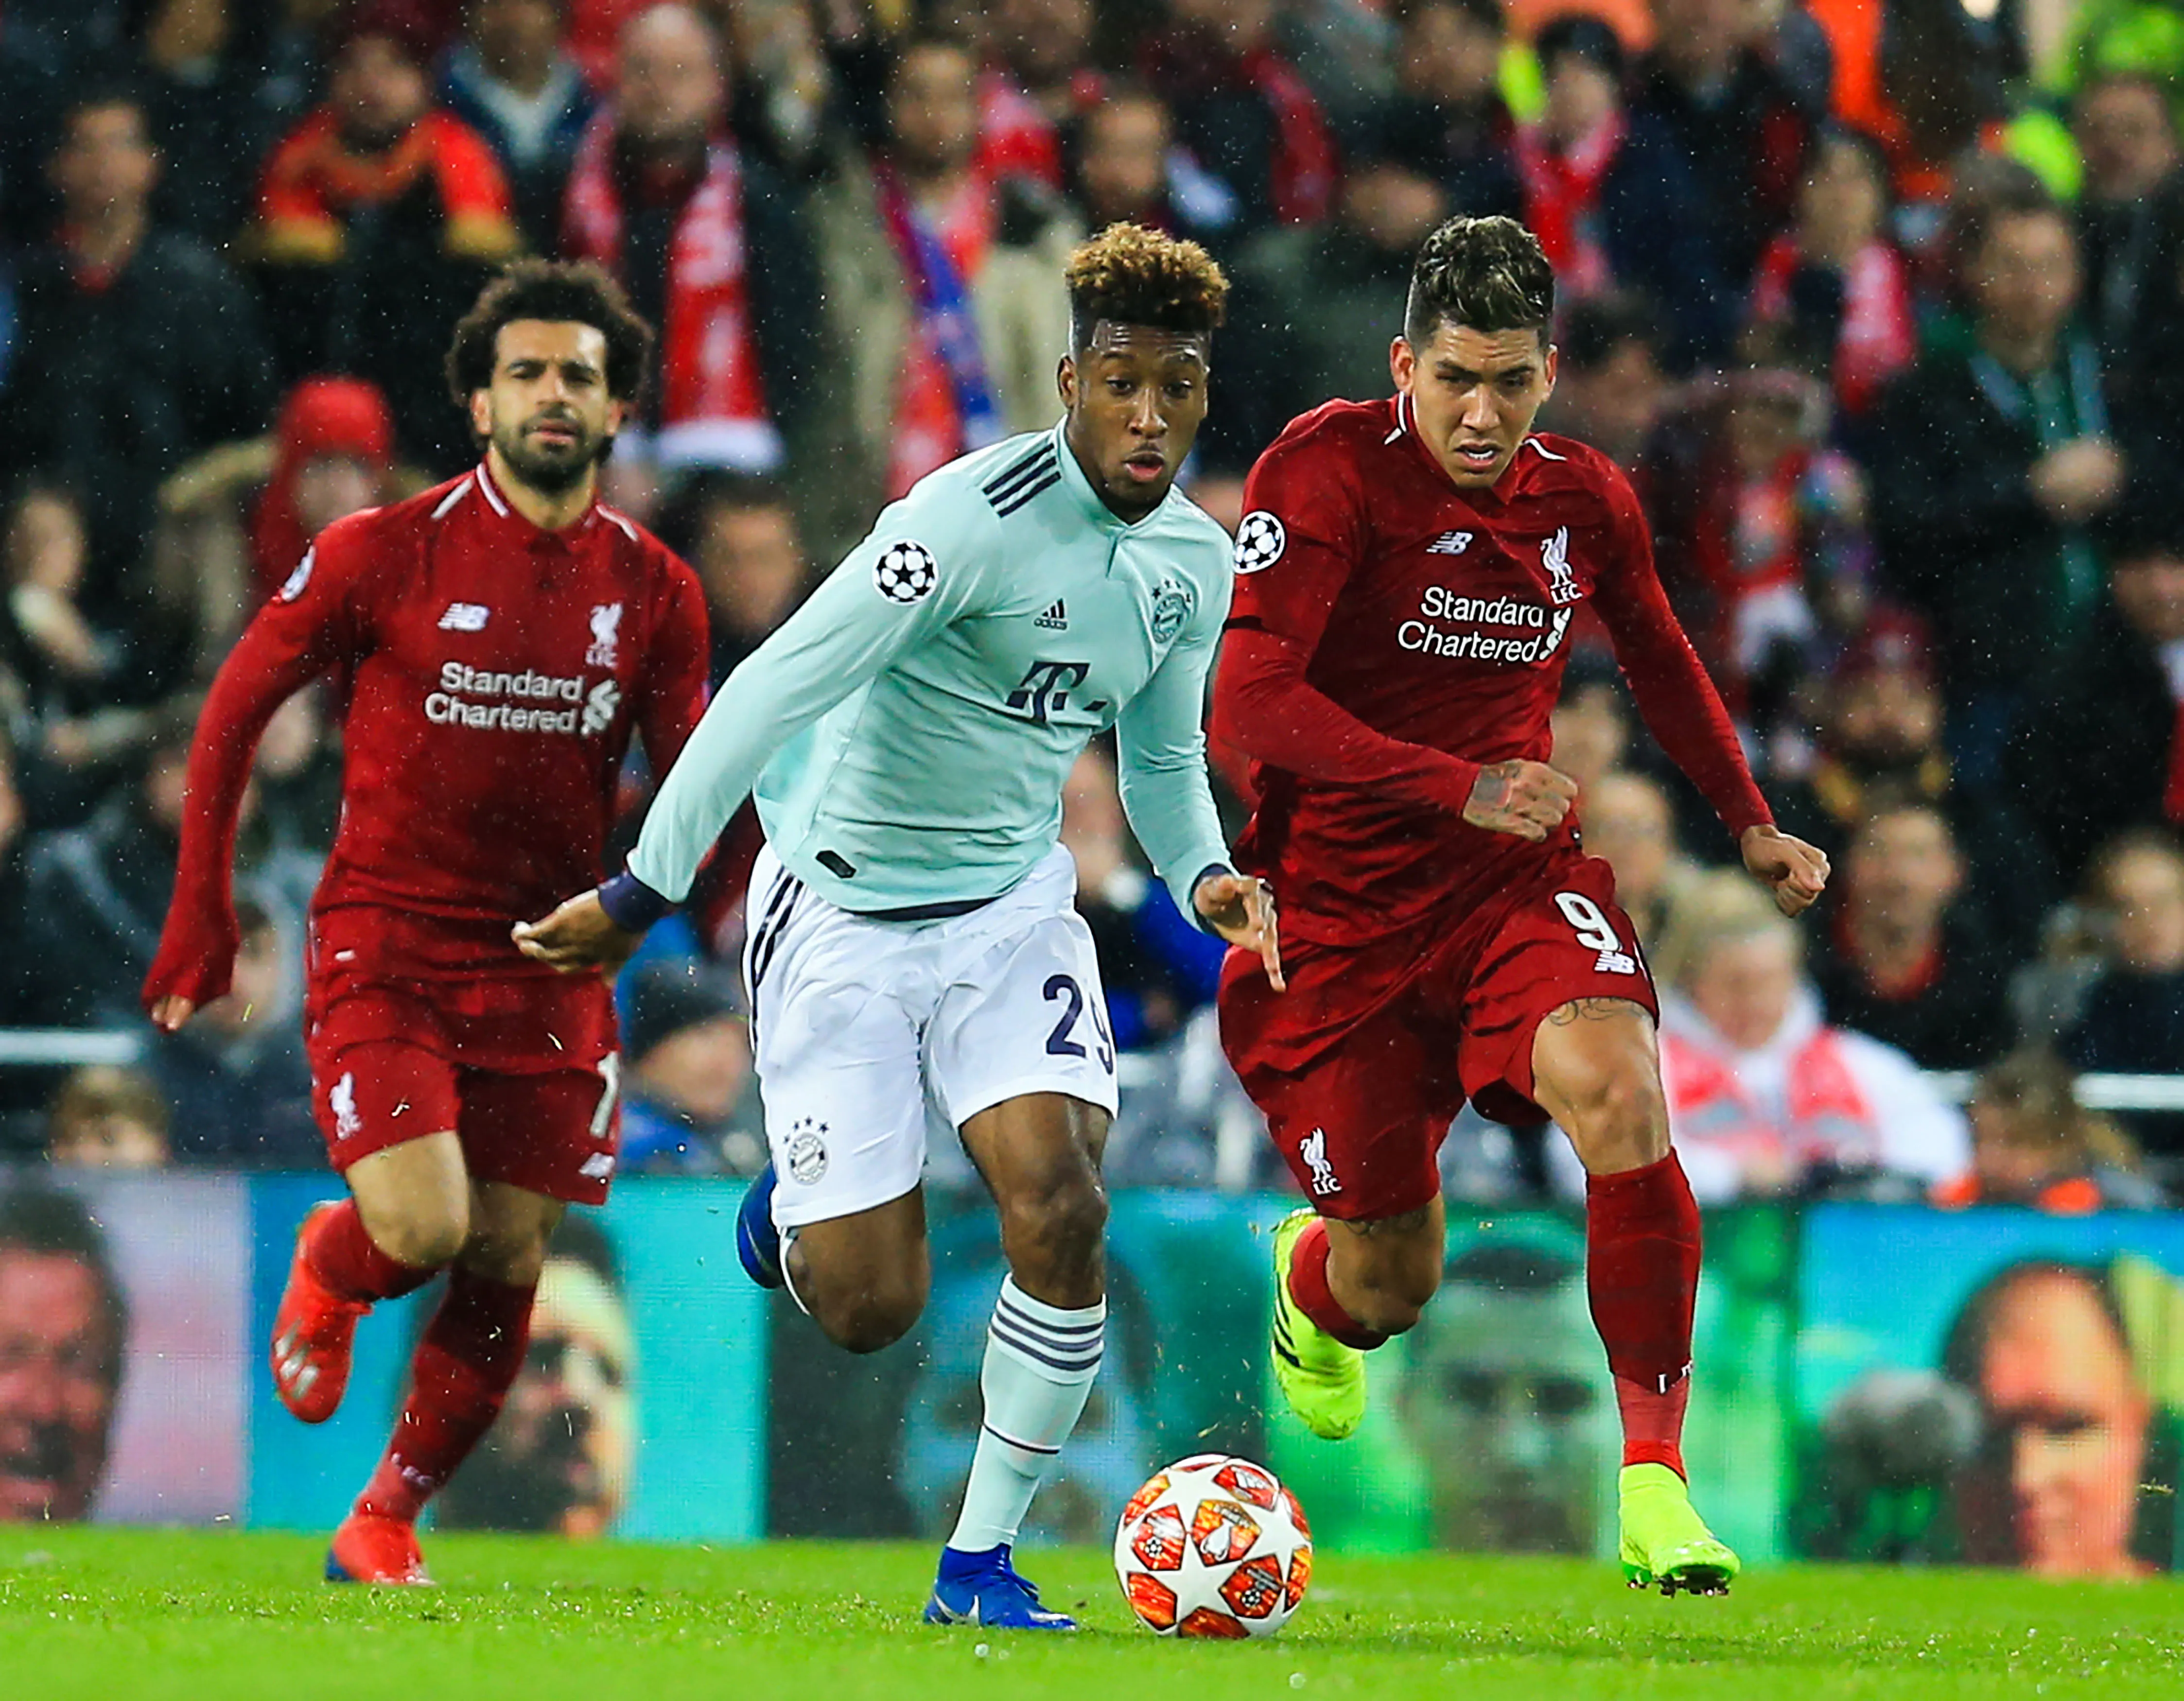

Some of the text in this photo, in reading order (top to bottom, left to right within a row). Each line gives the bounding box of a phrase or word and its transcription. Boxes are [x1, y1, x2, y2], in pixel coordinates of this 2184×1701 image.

[1421, 586, 1544, 627] Standard
[1398, 620, 1541, 662] Chartered
[439, 661, 585, 702] Standard
[424, 692, 578, 733] Chartered
[1555, 892, 1619, 952] 9
[1043, 974, 1114, 1076] 29
